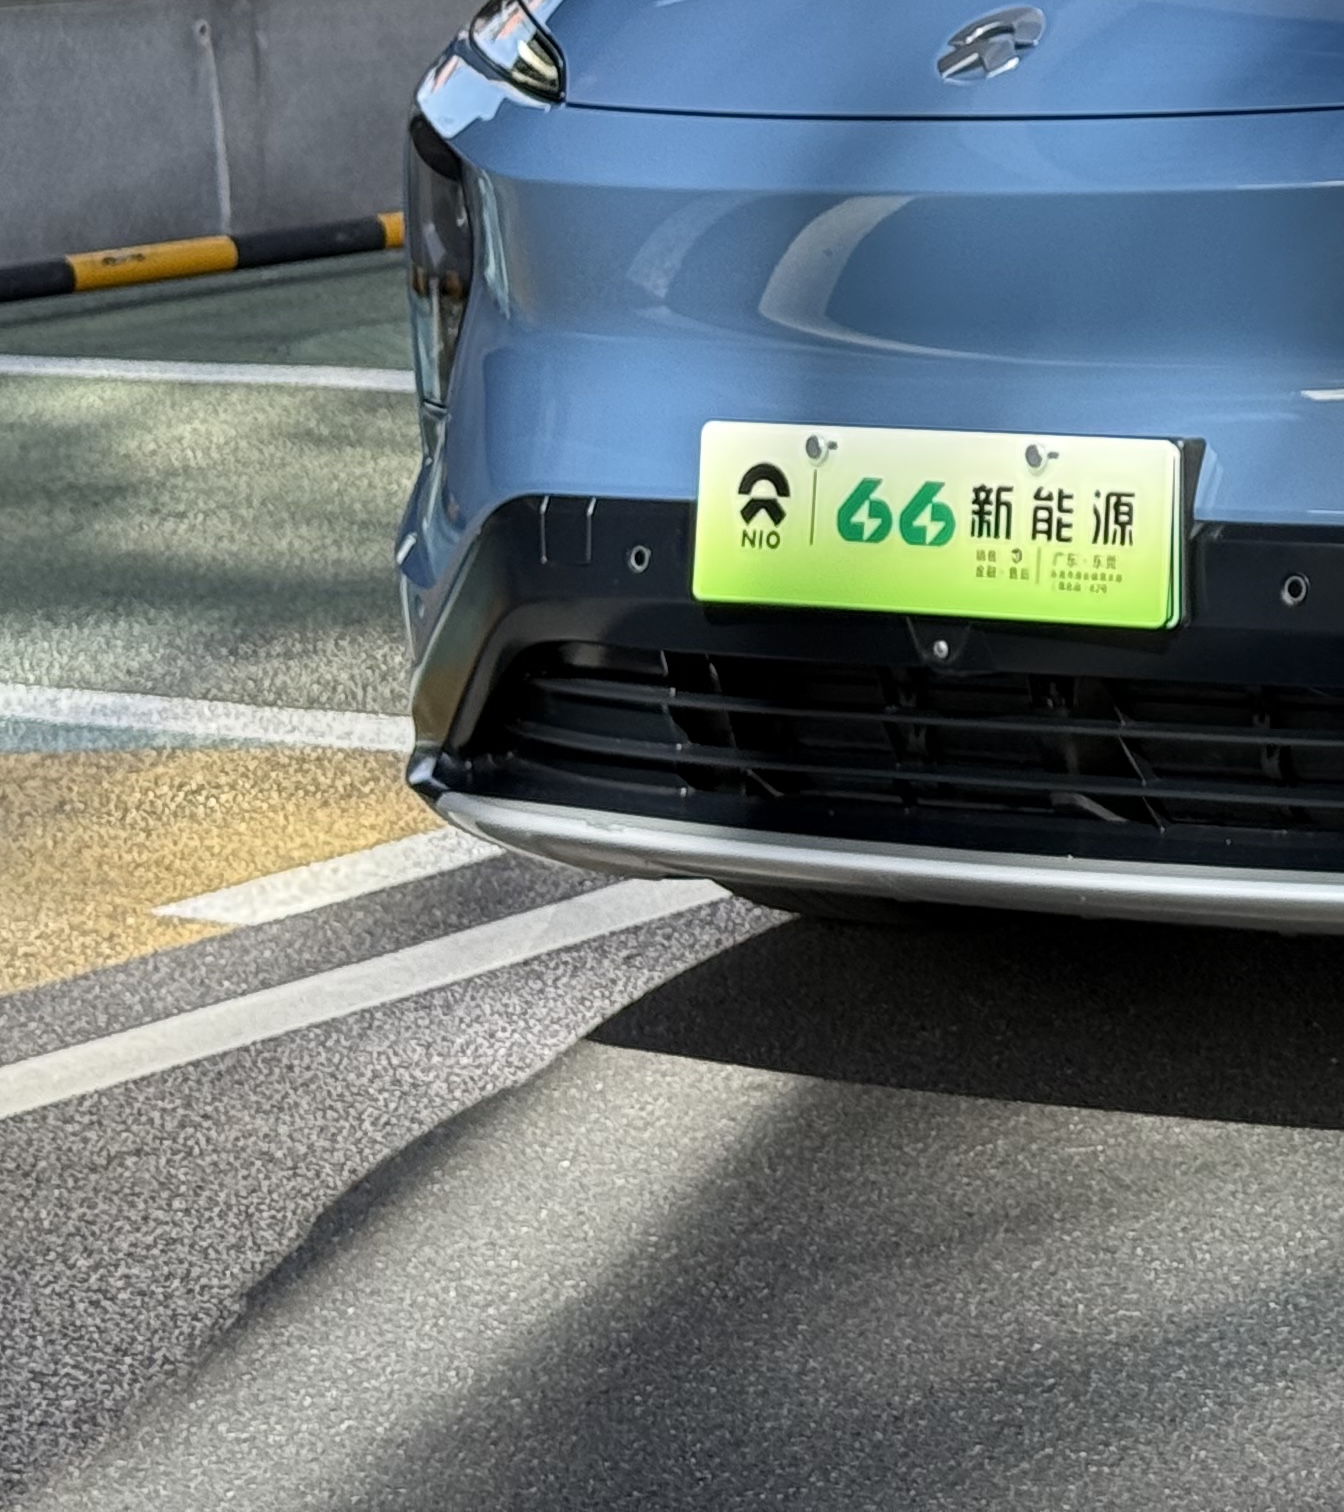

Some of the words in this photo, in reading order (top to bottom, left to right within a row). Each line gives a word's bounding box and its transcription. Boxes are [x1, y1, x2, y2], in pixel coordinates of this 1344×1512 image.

[837, 477, 956, 546] 66
[971, 484, 1136, 546] 新能源
[741, 529, 781, 549] NIO
